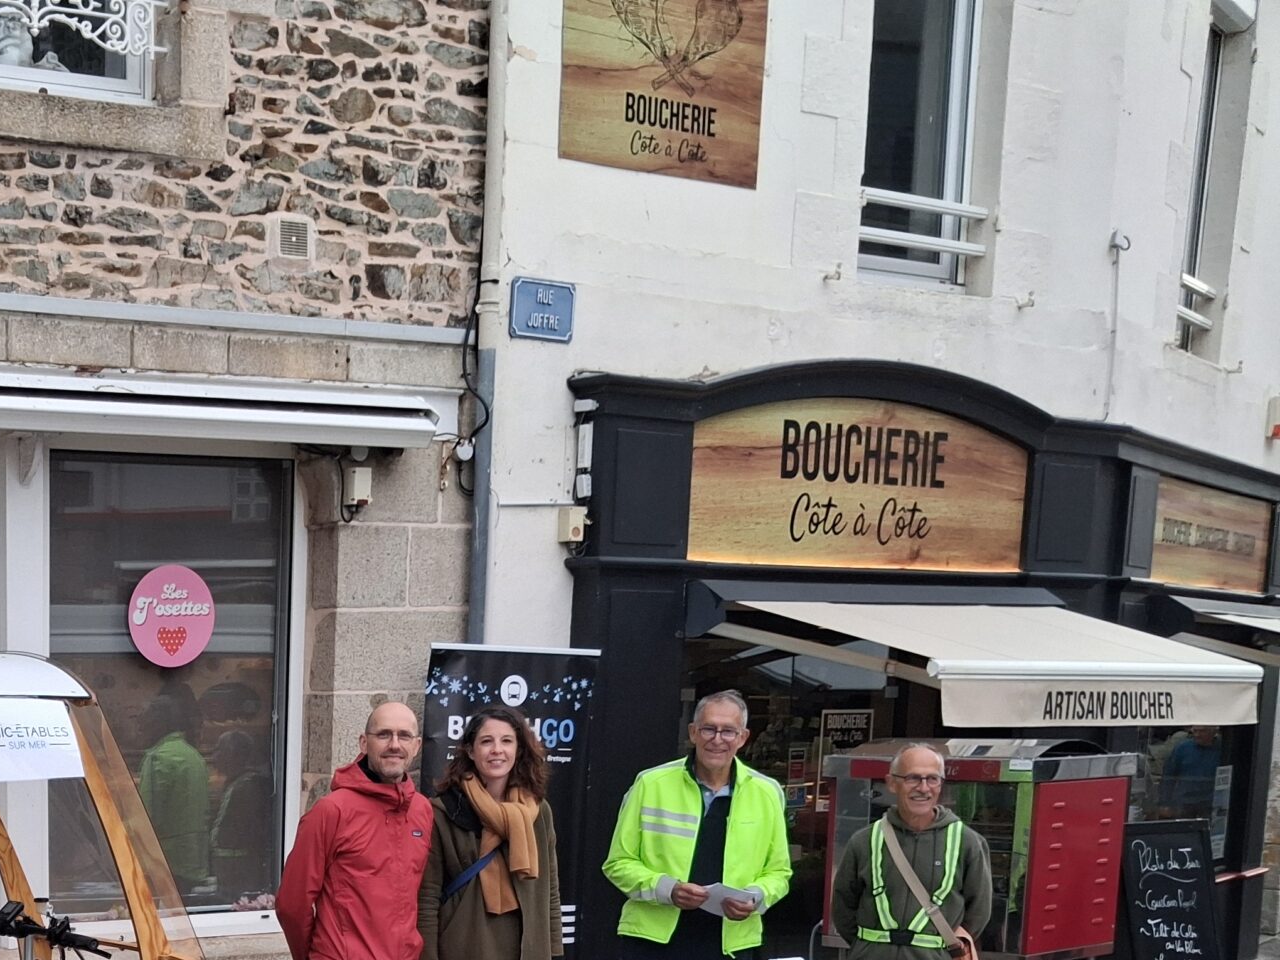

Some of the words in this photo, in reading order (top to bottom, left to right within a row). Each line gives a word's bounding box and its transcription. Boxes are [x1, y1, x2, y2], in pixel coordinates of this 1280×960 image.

[625, 91, 717, 137] BOUCHERIE
[630, 130, 661, 156] Côte
[664, 139, 673, 157] à
[678, 139, 708, 163] Côte
[537, 288, 554, 305] RUE
[527, 312, 560, 330] JOFFRE
[780, 419, 948, 488] BOUCHERIE
[790, 492, 848, 542] Côte
[854, 503, 871, 536] à
[877, 498, 932, 545] Côte
[161, 583, 188, 600] Les
[1043, 691, 1106, 720] ARTISAN
[1110, 691, 1174, 720] BOUCHER
[827, 714, 868, 729] BOUCHERIE
[9, 741, 26, 750] SUR
[29, 741, 47, 749] MER
